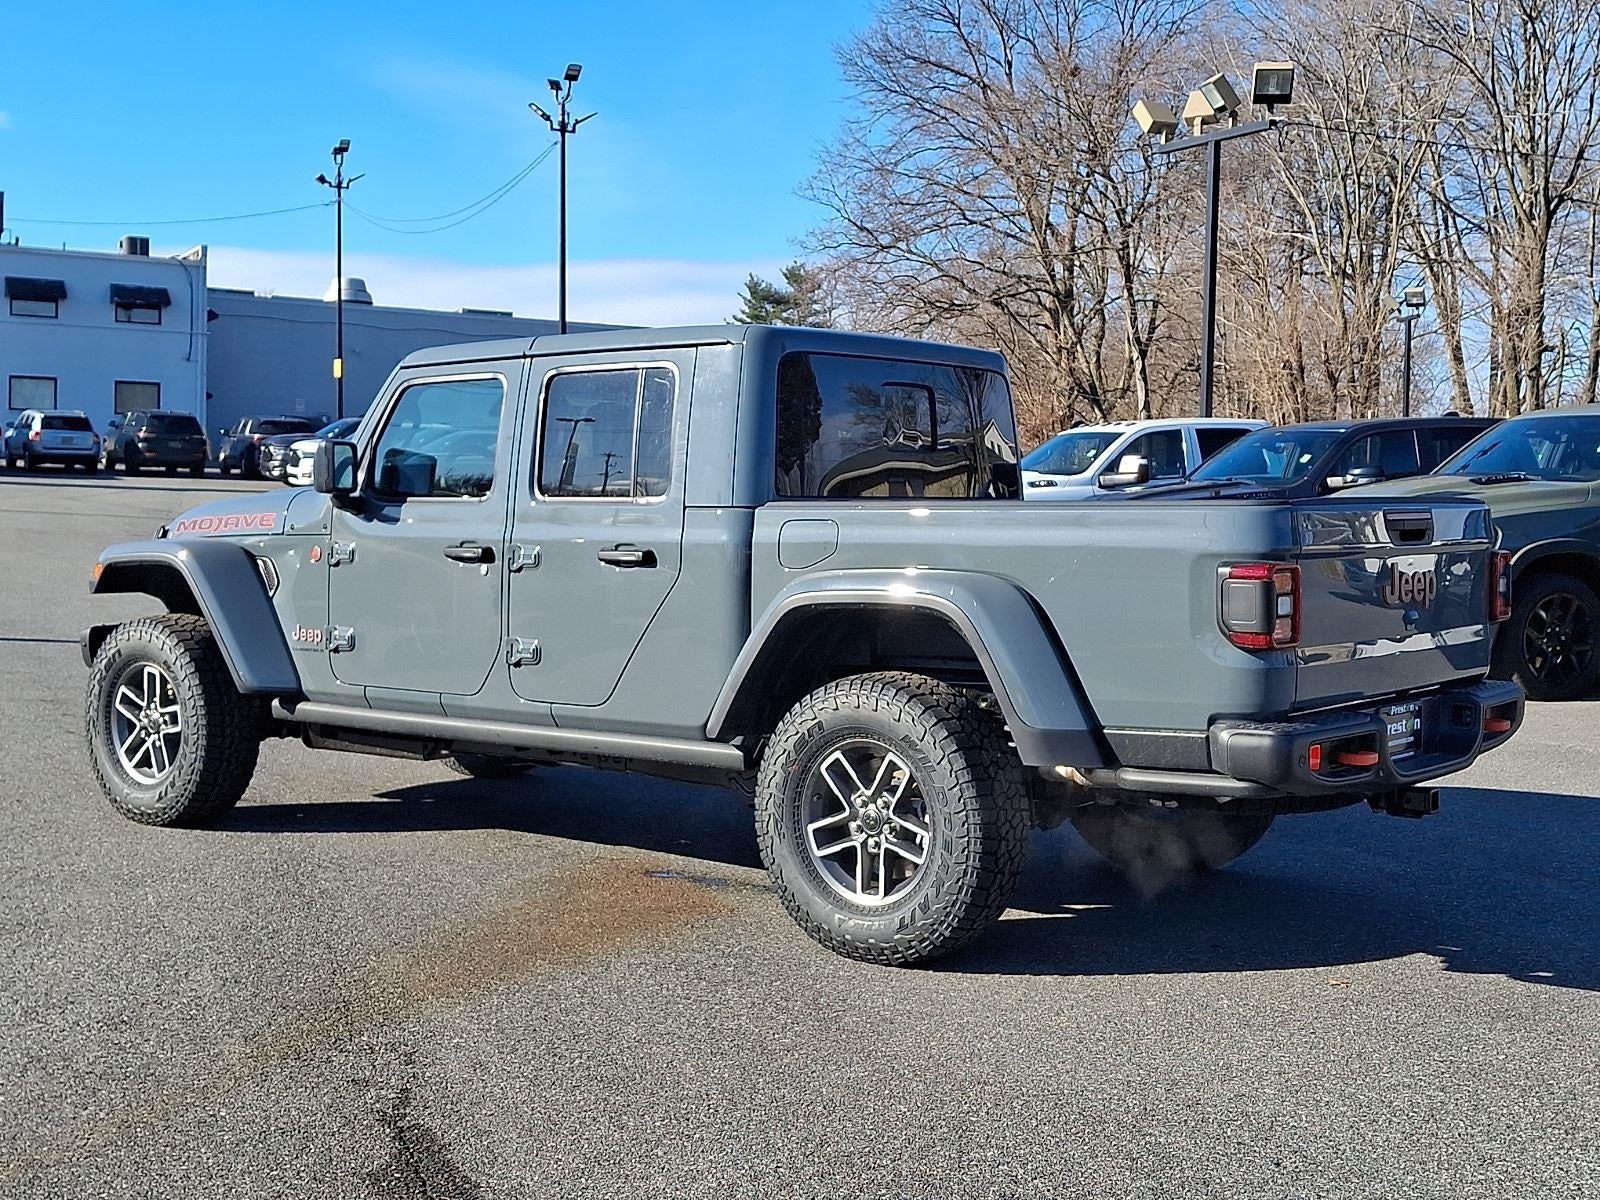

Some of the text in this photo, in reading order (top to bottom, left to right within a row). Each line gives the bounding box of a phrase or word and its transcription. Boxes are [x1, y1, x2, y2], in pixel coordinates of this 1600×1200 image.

[175, 512, 277, 534] MOJAVE
[1383, 562, 1437, 609] Jeep
[292, 624, 323, 646] Jeep
[1387, 717, 1421, 736] reston
